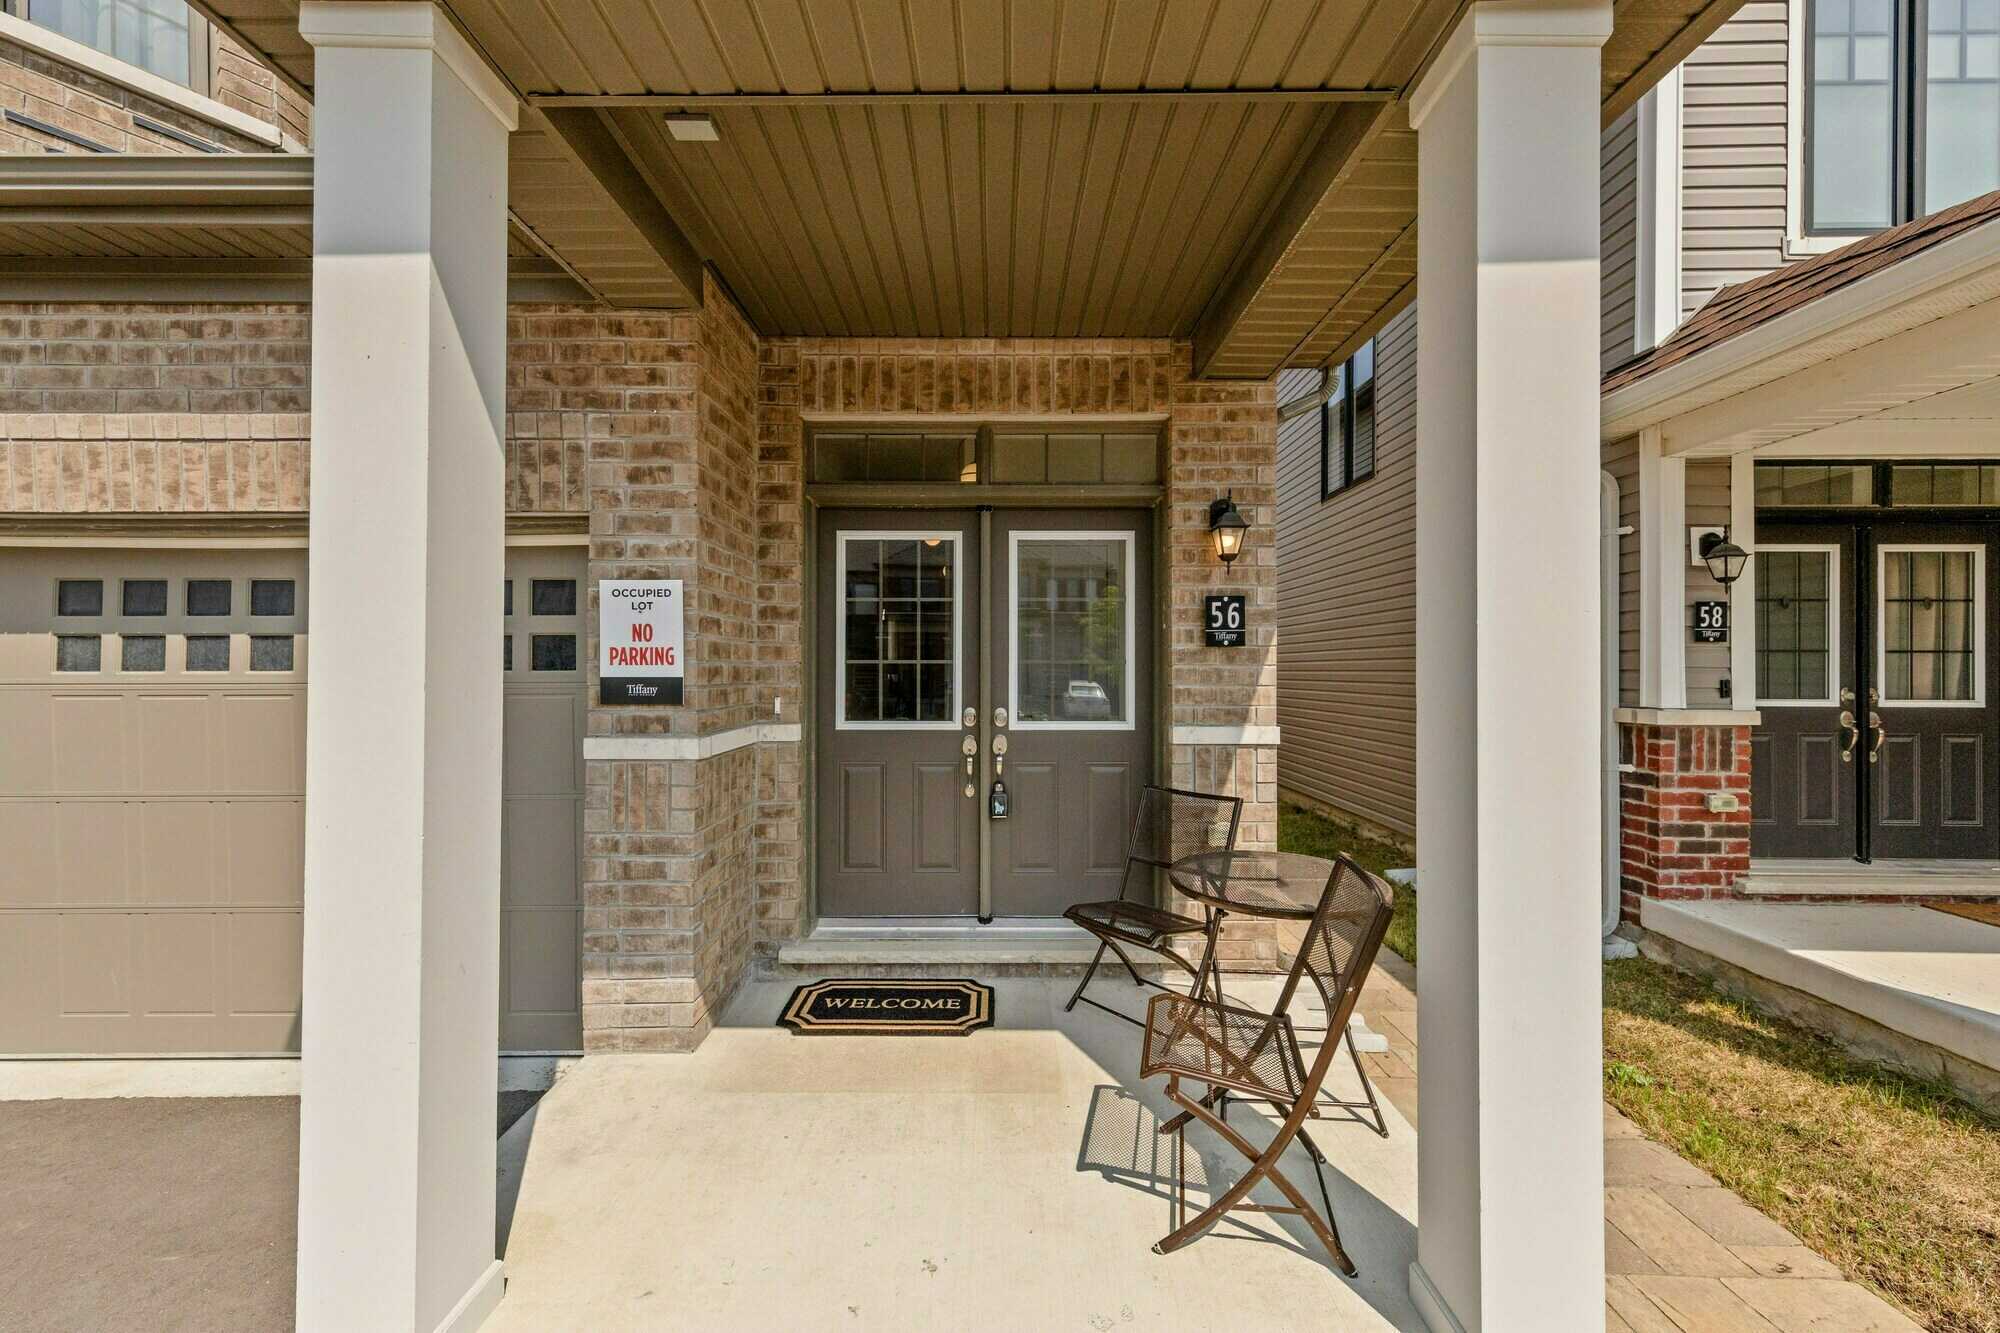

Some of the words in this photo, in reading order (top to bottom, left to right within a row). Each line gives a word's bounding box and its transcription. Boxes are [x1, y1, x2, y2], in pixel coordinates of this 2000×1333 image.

[611, 588, 672, 598] OCCUPIED
[631, 601, 654, 611] LOT
[1211, 601, 1240, 629] 56
[1700, 606, 1722, 628] 58
[631, 623, 653, 642] NO
[1214, 631, 1238, 641] Tiffany
[609, 646, 675, 666] PARKING
[626, 683, 658, 697] Tiffany
[824, 997, 961, 1009] WELCOME
